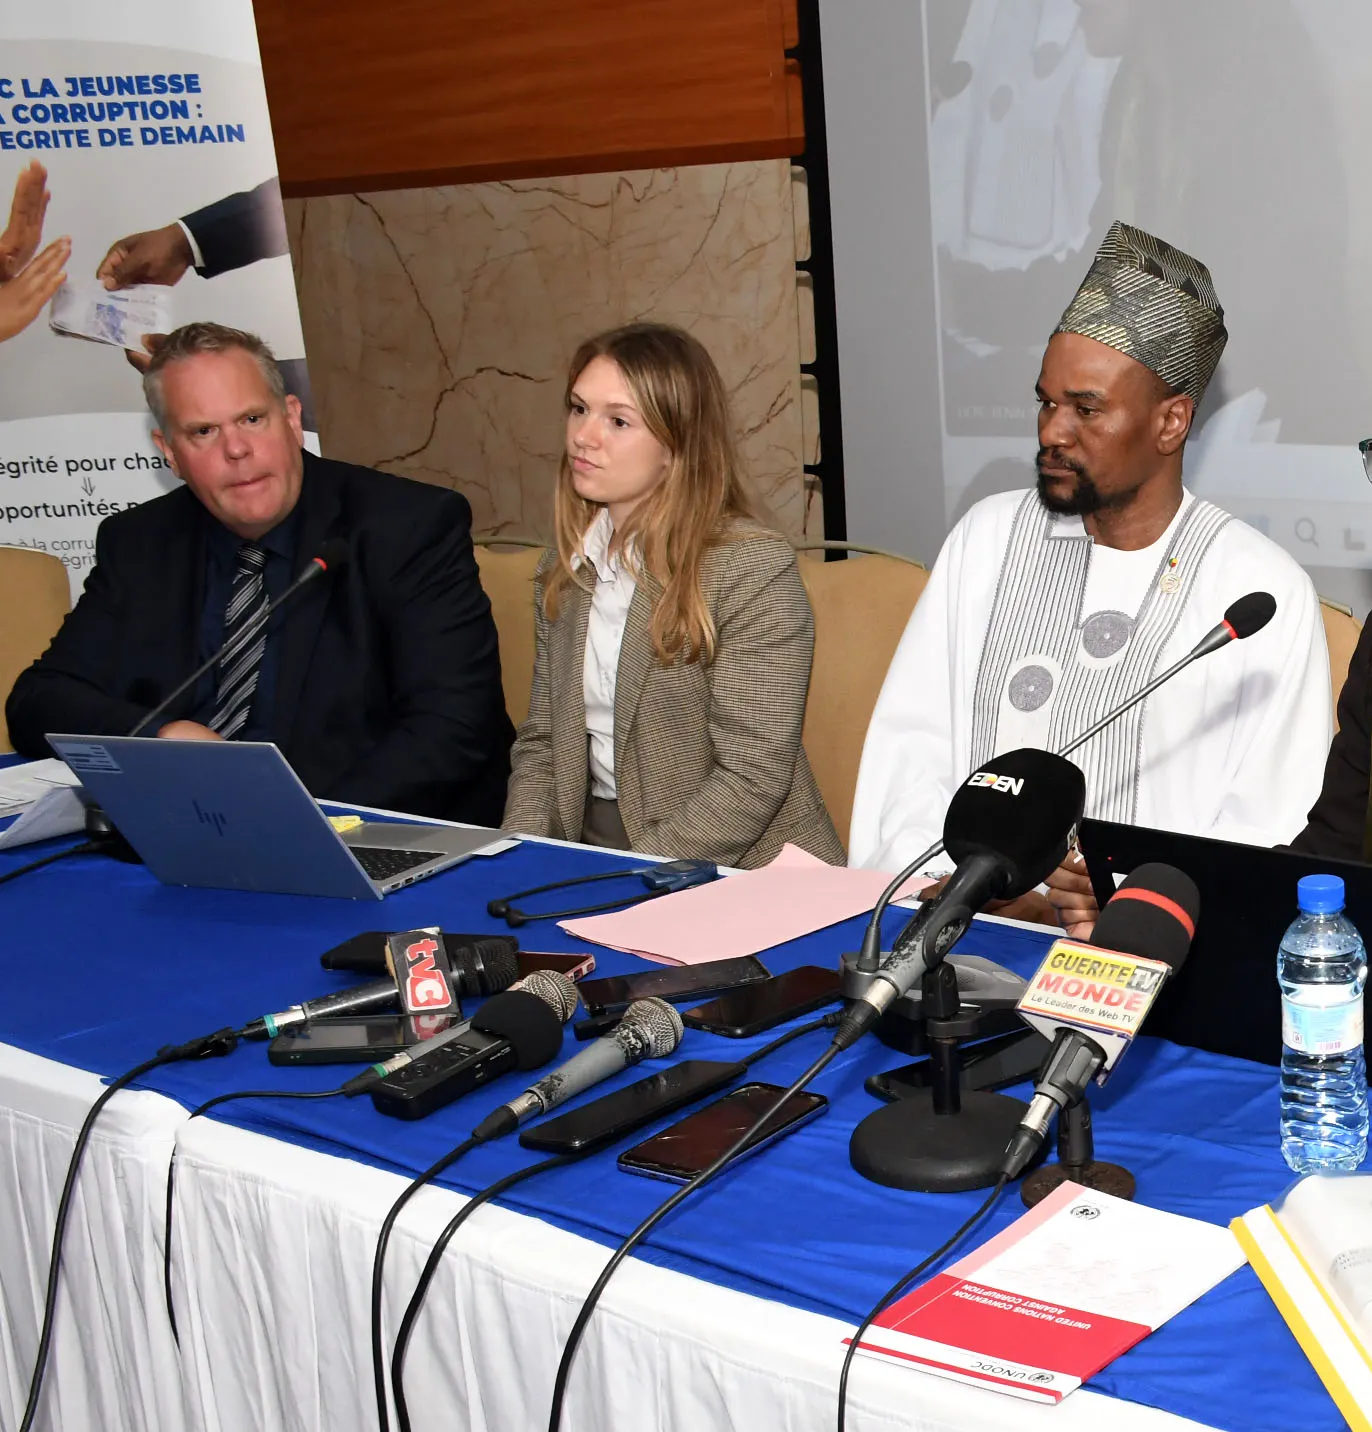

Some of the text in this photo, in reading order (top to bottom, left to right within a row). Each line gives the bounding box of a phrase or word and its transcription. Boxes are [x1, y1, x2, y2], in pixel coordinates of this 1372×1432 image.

[21, 78, 60, 98] LA
[65, 74, 201, 97] JEUNESSE
[12, 100, 189, 125] CORRUPTION
[0, 124, 245, 150] EGRITE DE DEMAIN
[65, 457, 117, 476] pour
[967, 772, 1024, 795] EDEN
[1050, 952, 1131, 983] GUERITE
[1036, 973, 1146, 1012] MONDE
[1031, 994, 1135, 1023] Le Leader des Web TV
[952, 1290, 1091, 1330] UNITED NATIONS CONVENTION
[961, 1284, 1065, 1315] AGAINST CORRUPTION
[970, 1361, 1026, 1378] UNODC
